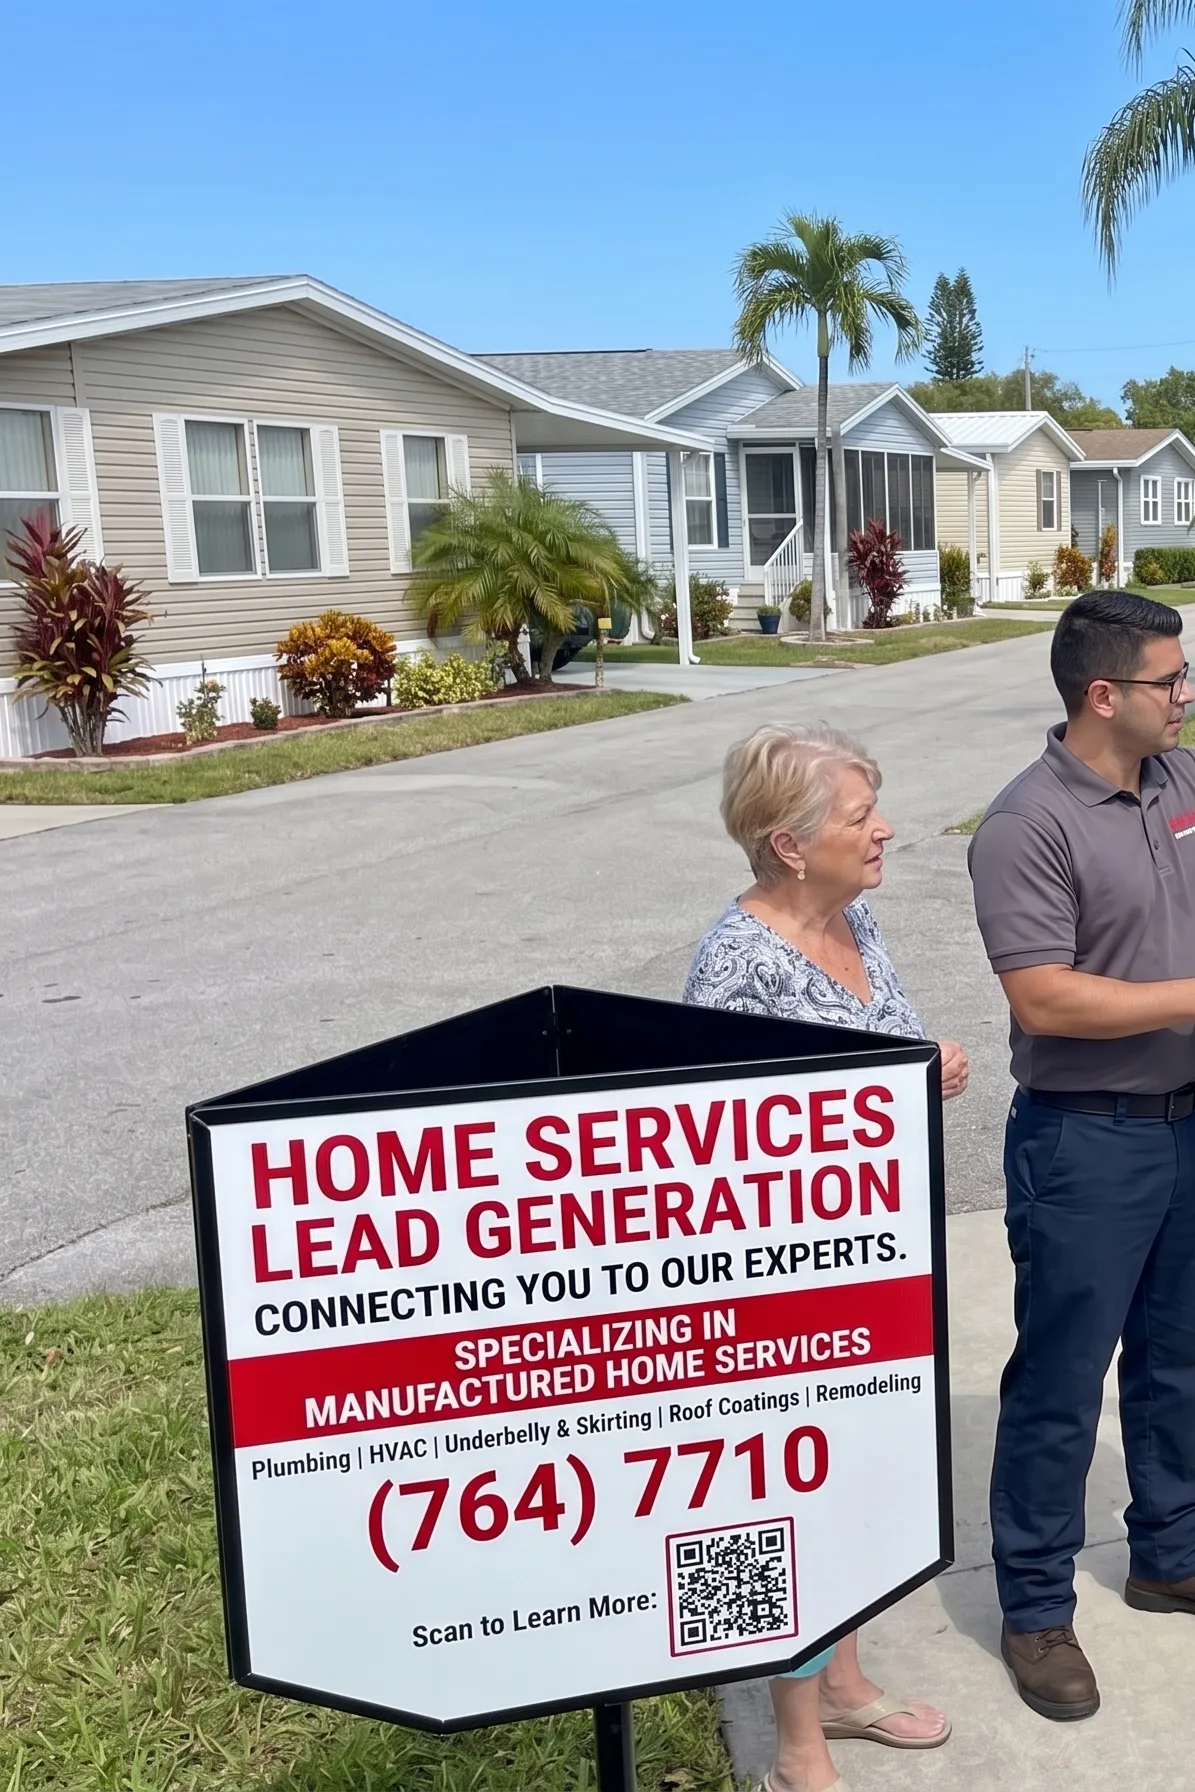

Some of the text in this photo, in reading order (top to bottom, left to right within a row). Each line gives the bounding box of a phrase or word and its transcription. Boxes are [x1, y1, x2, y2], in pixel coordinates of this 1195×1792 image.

[252, 1086, 894, 1209] HOME SERVICES
[252, 1159, 900, 1283] LEAD GENERATION
[255, 1233, 906, 1335] CONNECTING YOU TO OUR EXPERTS.
[306, 1328, 870, 1427] MANUFACTURED HOME SERVICES
[456, 1309, 735, 1370] SPECIALIZING IN
[252, 1452, 350, 1480] Plumbing
[370, 1439, 427, 1464] HVAC
[446, 1422, 550, 1452] Underbelly
[557, 1419, 570, 1437] &
[577, 1411, 651, 1434] Skirting
[670, 1399, 712, 1422] Roof
[719, 1392, 799, 1415] Coatings
[817, 1374, 920, 1402] Remodeling
[369, 1426, 828, 1573] (764) 7710
[413, 1593, 656, 1647] Scan to Learn More:
